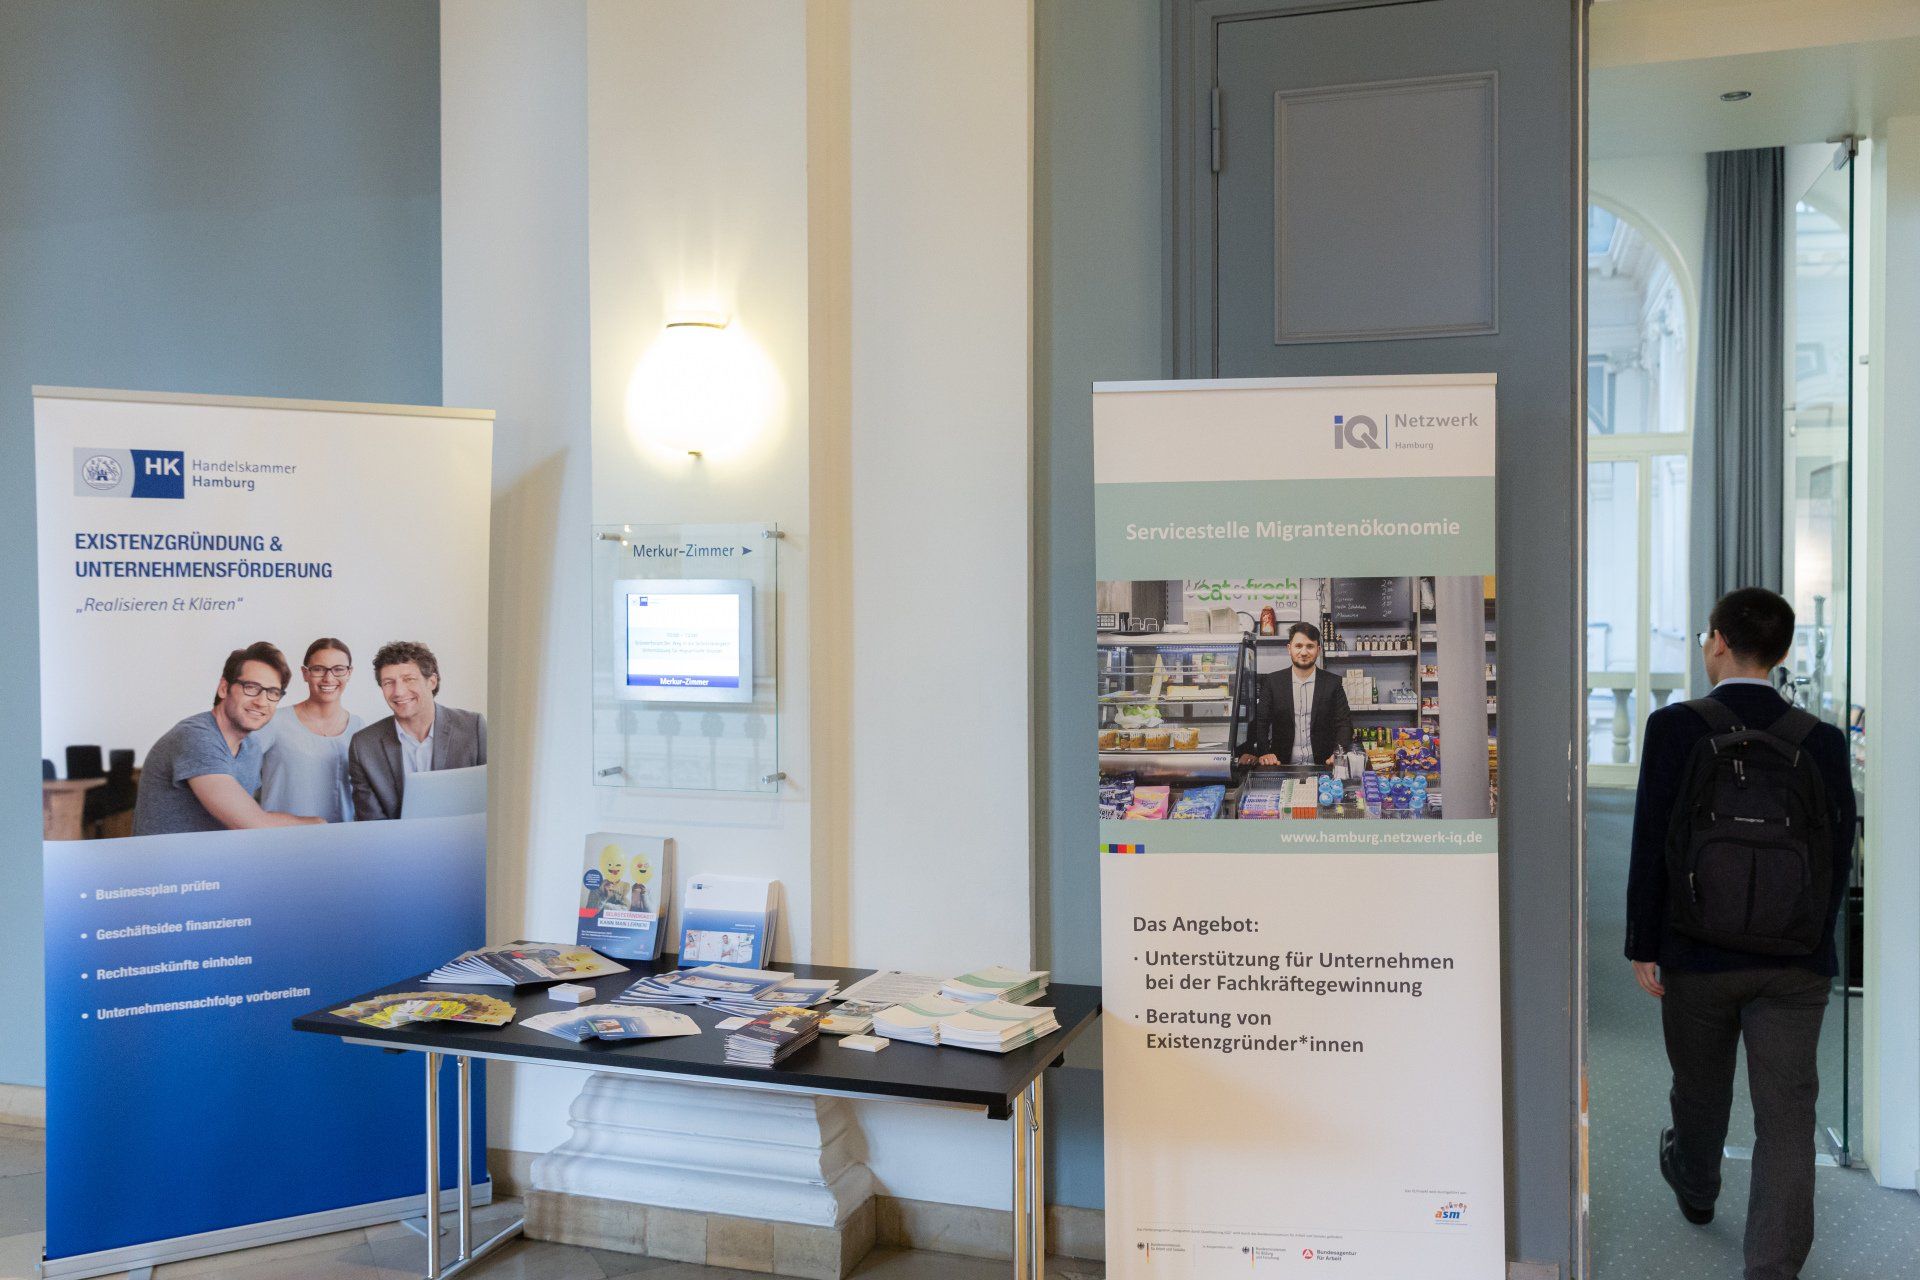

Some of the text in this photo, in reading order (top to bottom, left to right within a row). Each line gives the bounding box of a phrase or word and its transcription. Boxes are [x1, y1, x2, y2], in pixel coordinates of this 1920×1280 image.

[1394, 412, 1479, 428] Netzwerk
[1333, 414, 1382, 450] iQ
[1394, 441, 1434, 451] Hamburg
[144, 456, 181, 476] HK
[192, 459, 297, 475] Handelskammer
[192, 475, 255, 492] Hamburg
[1125, 517, 1461, 542] Servicestelle Migrantenökonomie
[75, 532, 283, 552] EXISTENZGRÜNDUNG &
[633, 543, 735, 558] Merkur-Zimmer
[75, 559, 333, 579] UNTERNEHMENSFÖRDERUNG
[659, 677, 710, 687] Merkur-Zimmer
[1280, 830, 1483, 847] www.hamburg.netzwerk-iq.de
[95, 879, 221, 901] Businessplan prüfen
[96, 917, 252, 941] Geschäftsidee finanzieren
[1133, 915, 1260, 936] Das Angebot:
[96, 956, 253, 981] Rechtsauskünfte einholen
[1145, 950, 1454, 971] Unterstützung für Unternehmen
[1145, 974, 1423, 997] bei der Fachkräftegewinnung
[96, 987, 312, 1020] Unternehmensnachfolge vorbereiten
[1146, 1008, 1272, 1028] Beratung von
[1435, 1210, 1461, 1219] asm
[1316, 1249, 1358, 1257] Bundesagentur
